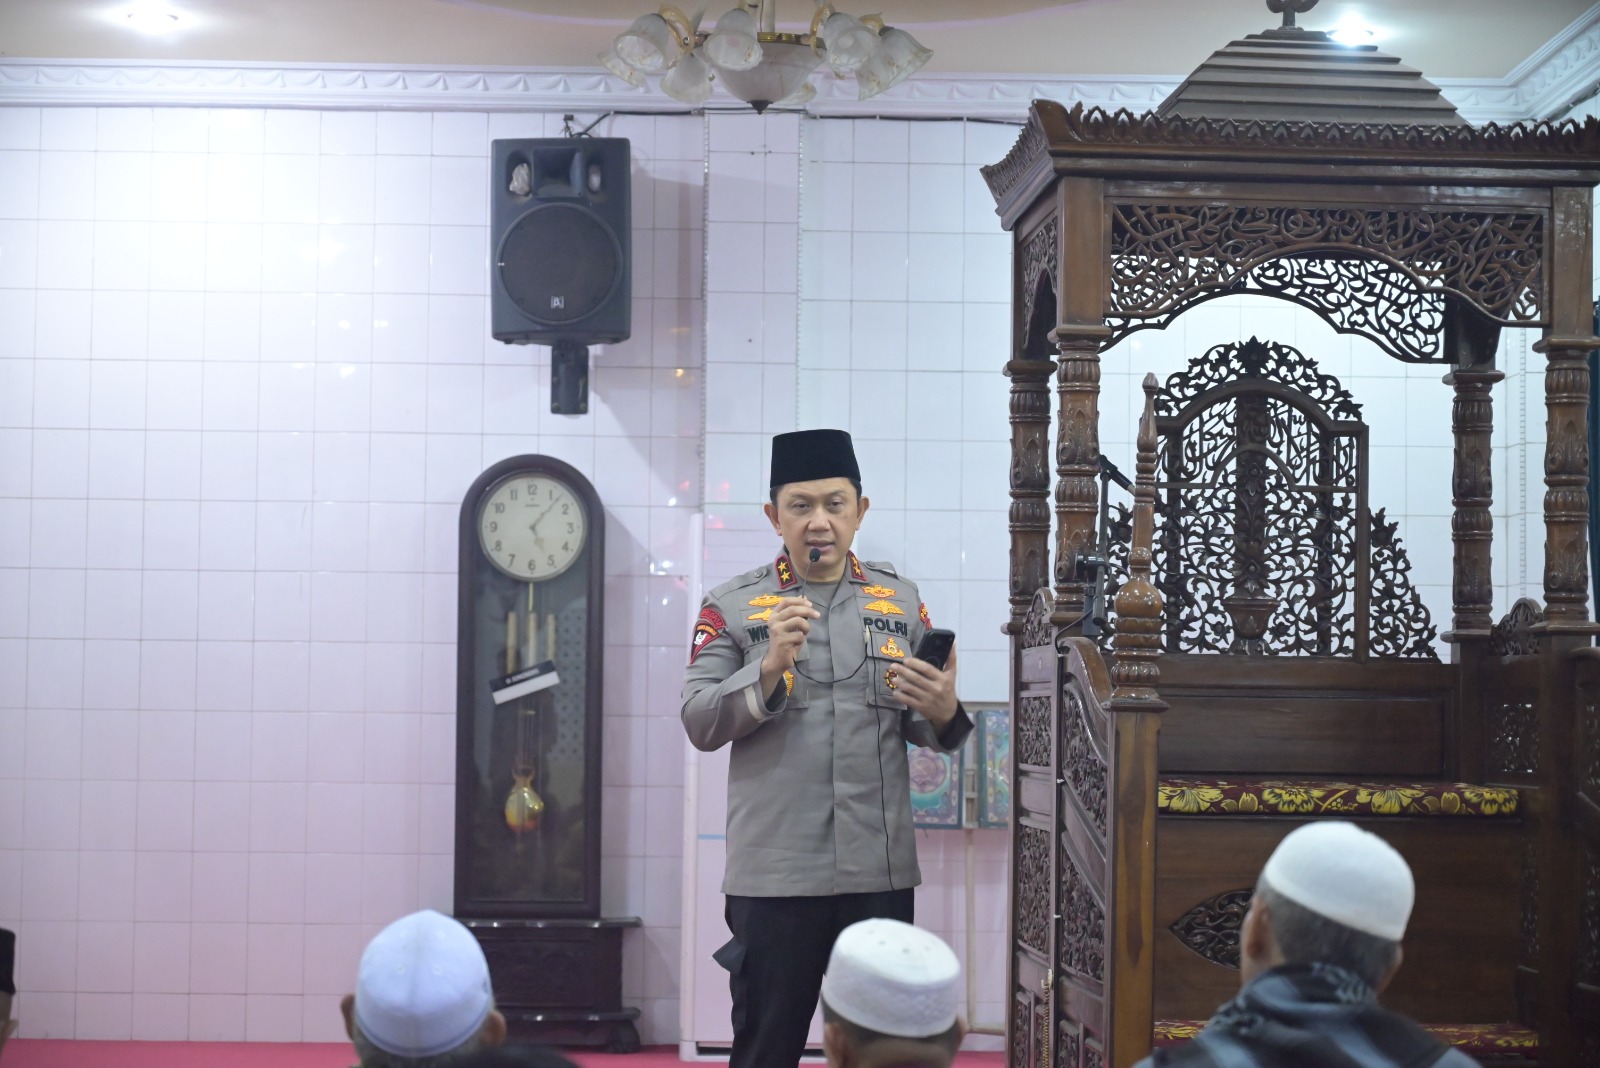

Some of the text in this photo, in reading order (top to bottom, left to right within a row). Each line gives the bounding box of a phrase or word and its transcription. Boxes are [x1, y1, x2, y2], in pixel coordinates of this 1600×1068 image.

[510, 489, 518, 500] 11
[528, 484, 537, 495] 12
[495, 502, 505, 513] 10
[562, 503, 569, 515] 2
[489, 521, 498, 533] 9
[566, 522, 574, 534] 3
[494, 540, 502, 552] 8
[561, 541, 569, 552] 4
[508, 553, 516, 566] 7
[528, 559, 536, 571] 6
[547, 554, 555, 566] 5
[864, 617, 908, 636] POLRI
